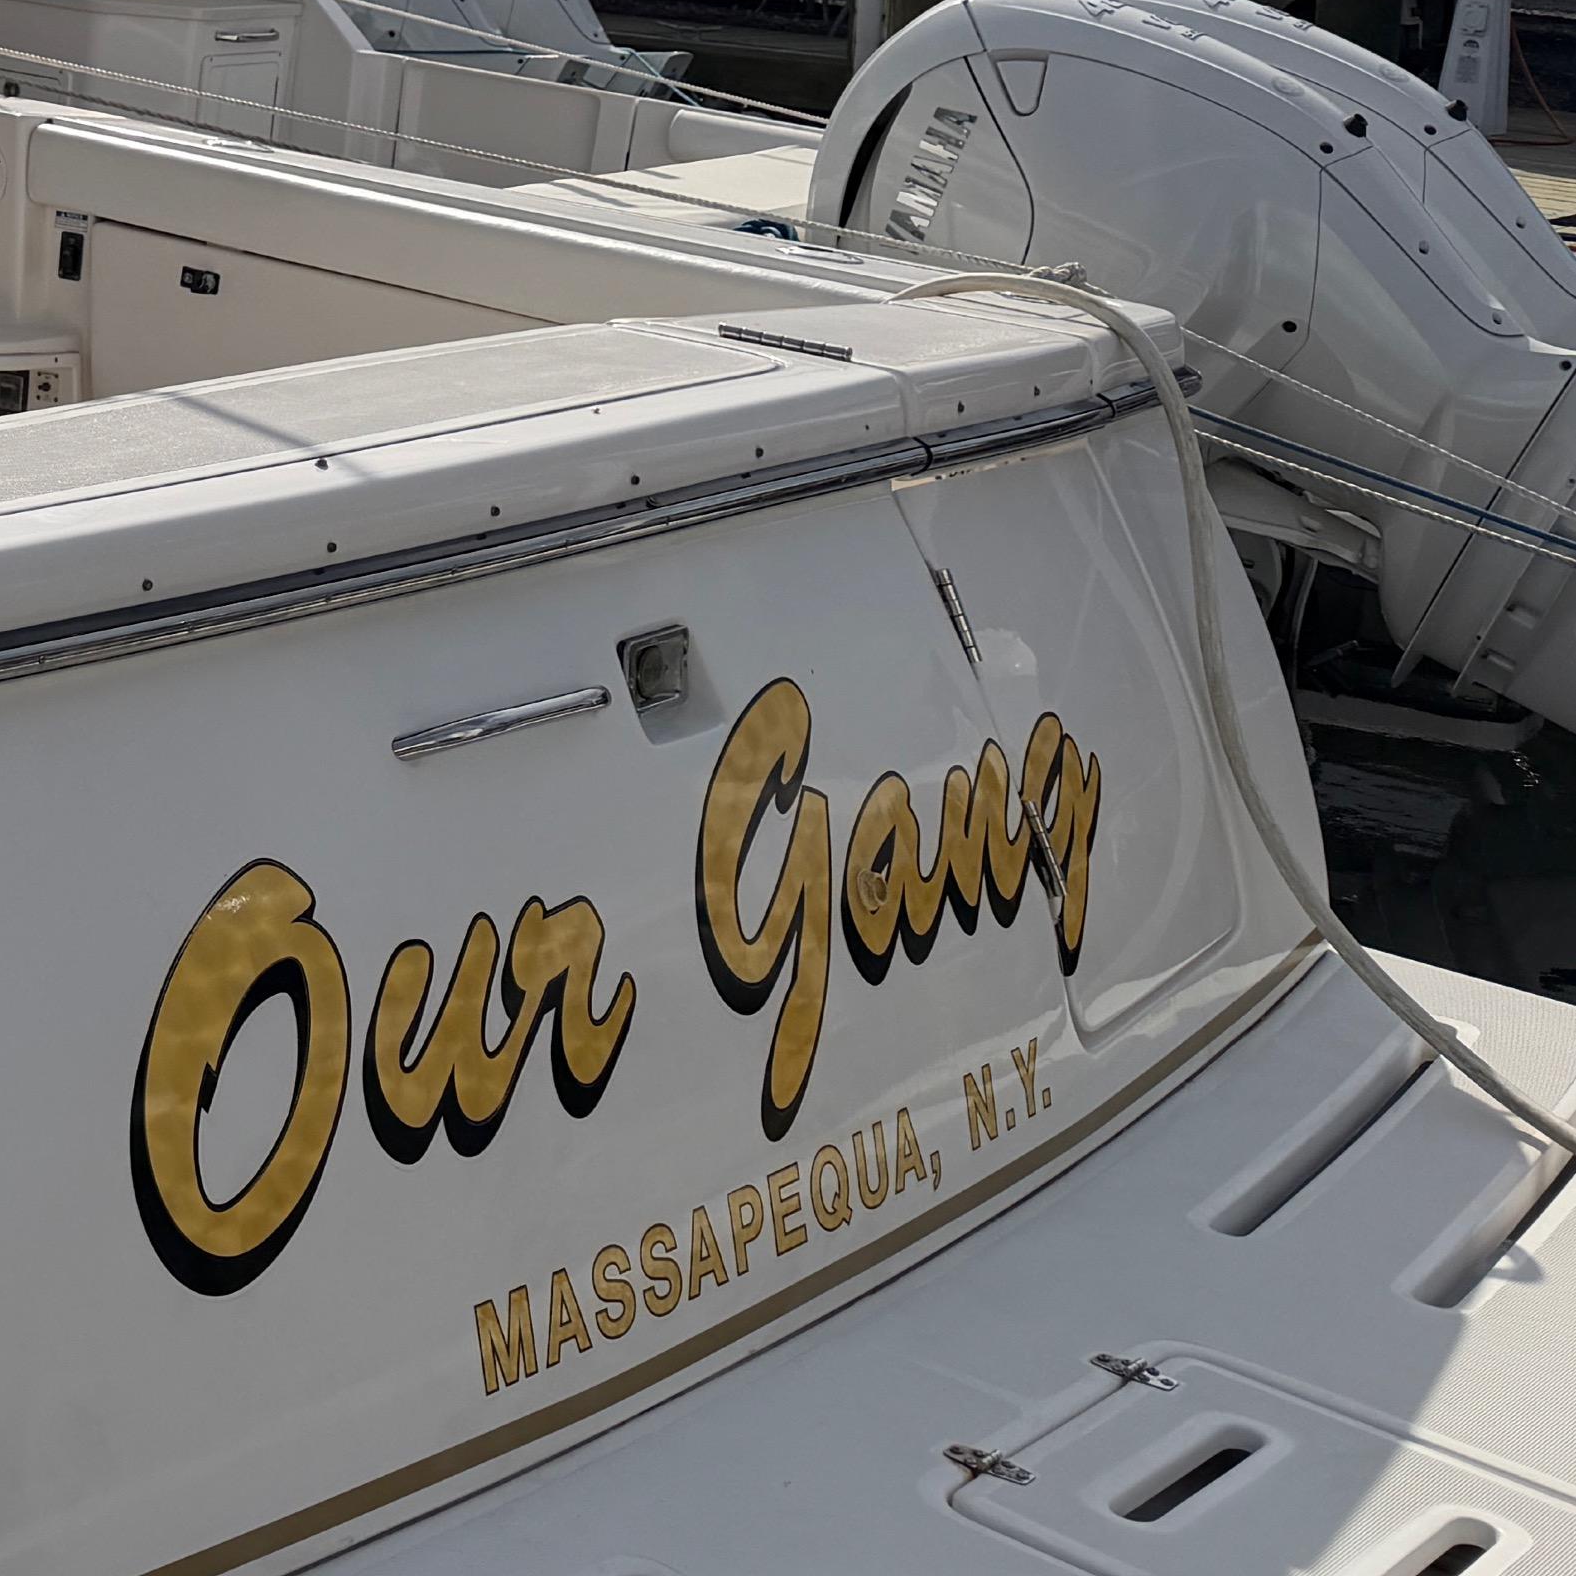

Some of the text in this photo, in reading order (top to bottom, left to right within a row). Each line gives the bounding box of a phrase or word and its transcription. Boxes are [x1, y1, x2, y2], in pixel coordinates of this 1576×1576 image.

[130, 676, 1102, 1297] Our Gang
[474, 1037, 1051, 1396] MASSAPEQUA, N.Y.
